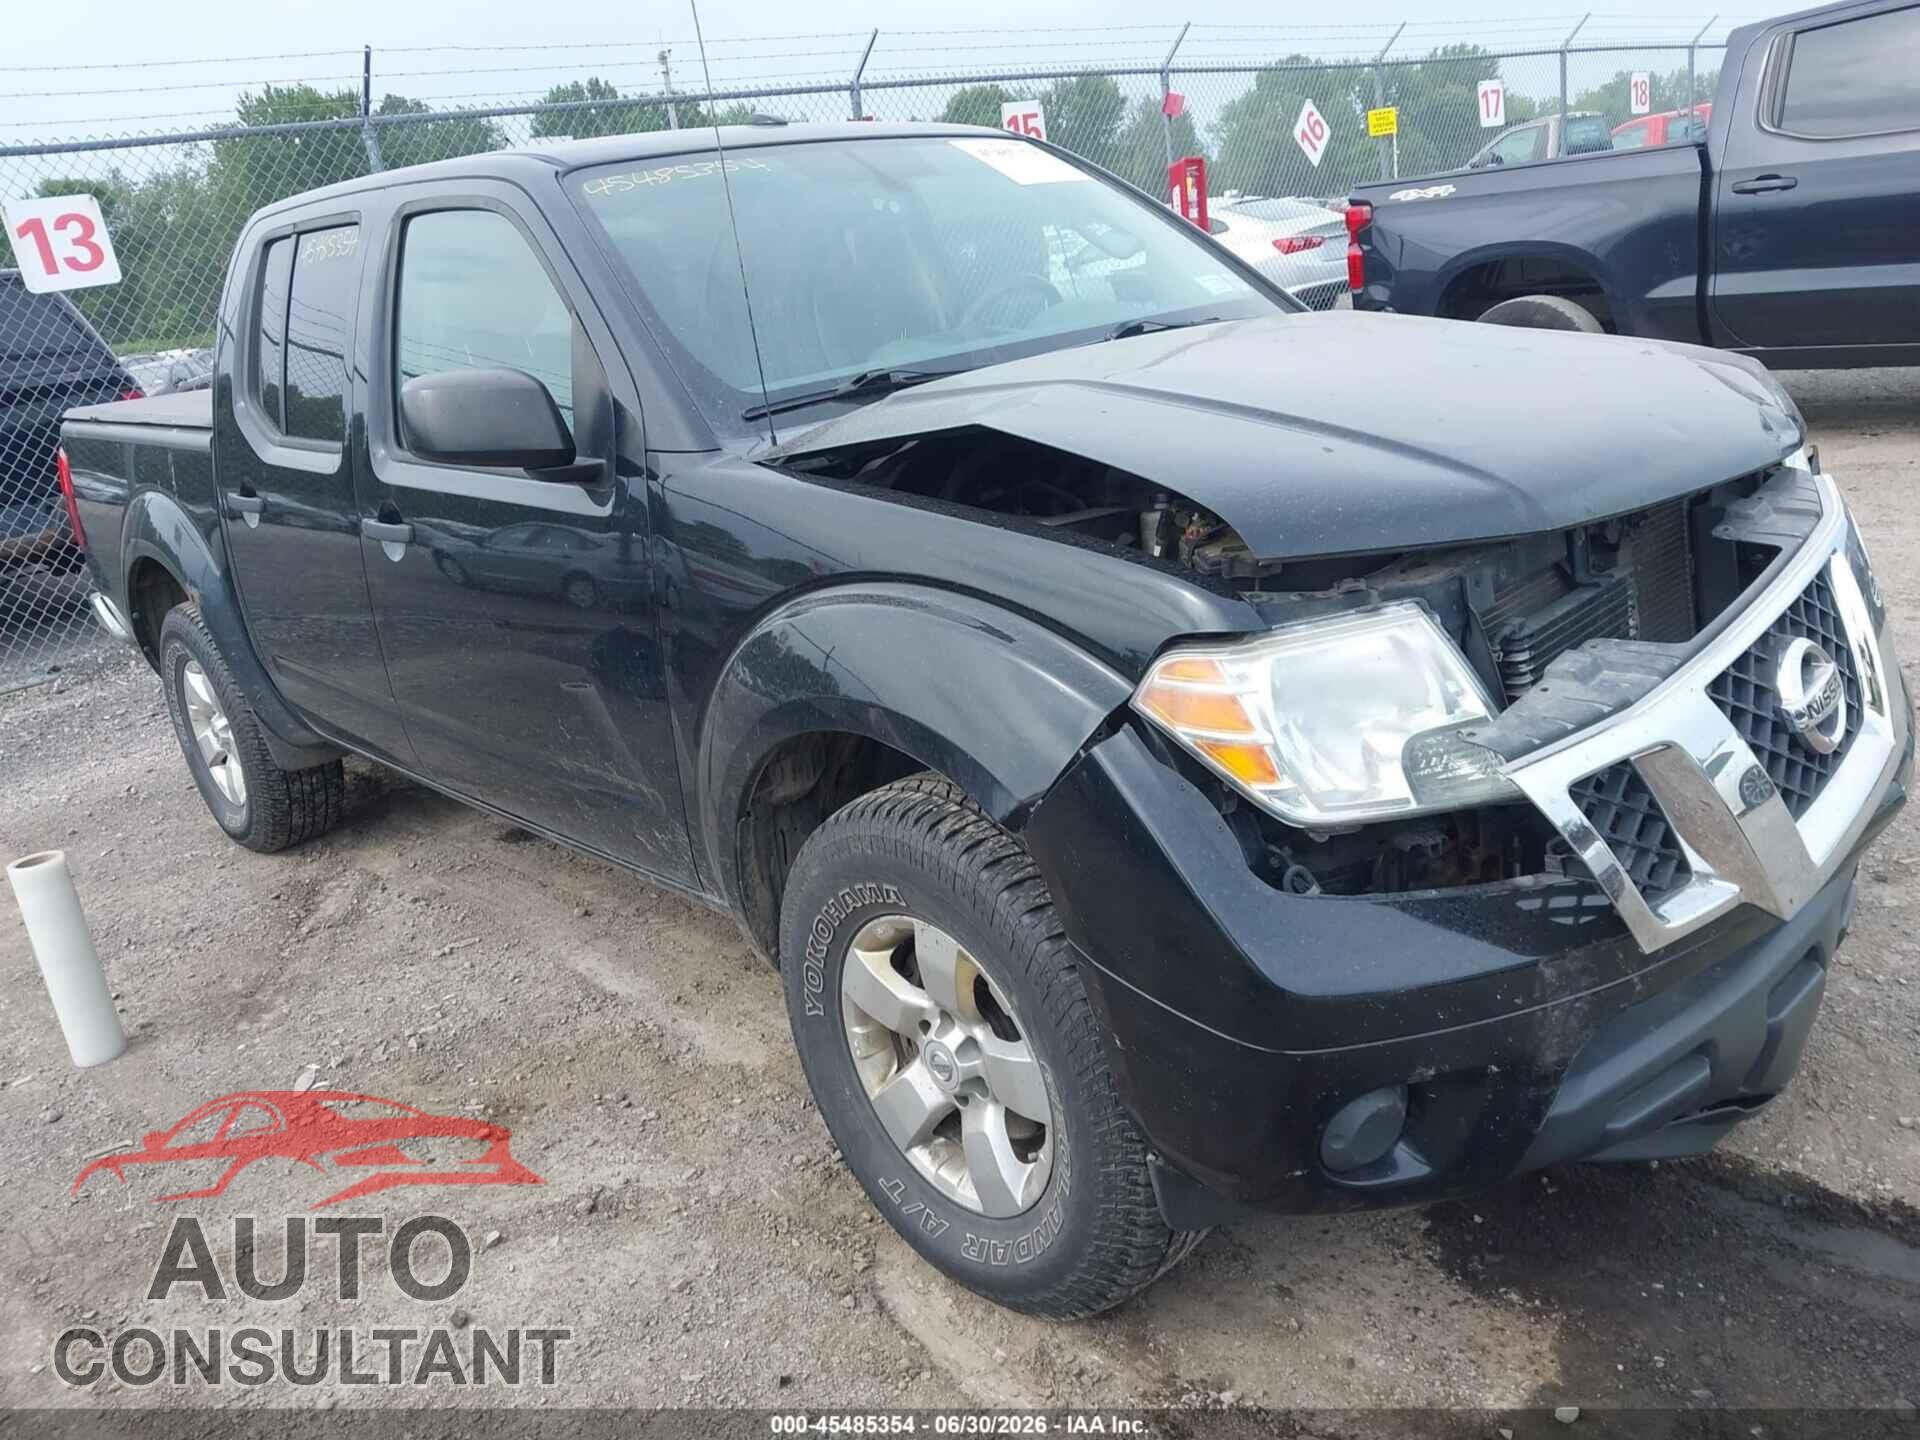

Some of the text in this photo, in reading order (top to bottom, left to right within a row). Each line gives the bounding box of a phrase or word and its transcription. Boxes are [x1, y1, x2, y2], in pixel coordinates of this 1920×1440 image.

[1480, 88, 1501, 119] 17
[1632, 79, 1649, 107] 18
[1006, 112, 1043, 139] 15
[1300, 111, 1326, 152] 16
[16, 213, 105, 276] 13
[1806, 677, 1842, 721] NISS
[803, 881, 908, 1017] YOKOHAMA
[878, 1177, 950, 1239] A/T
